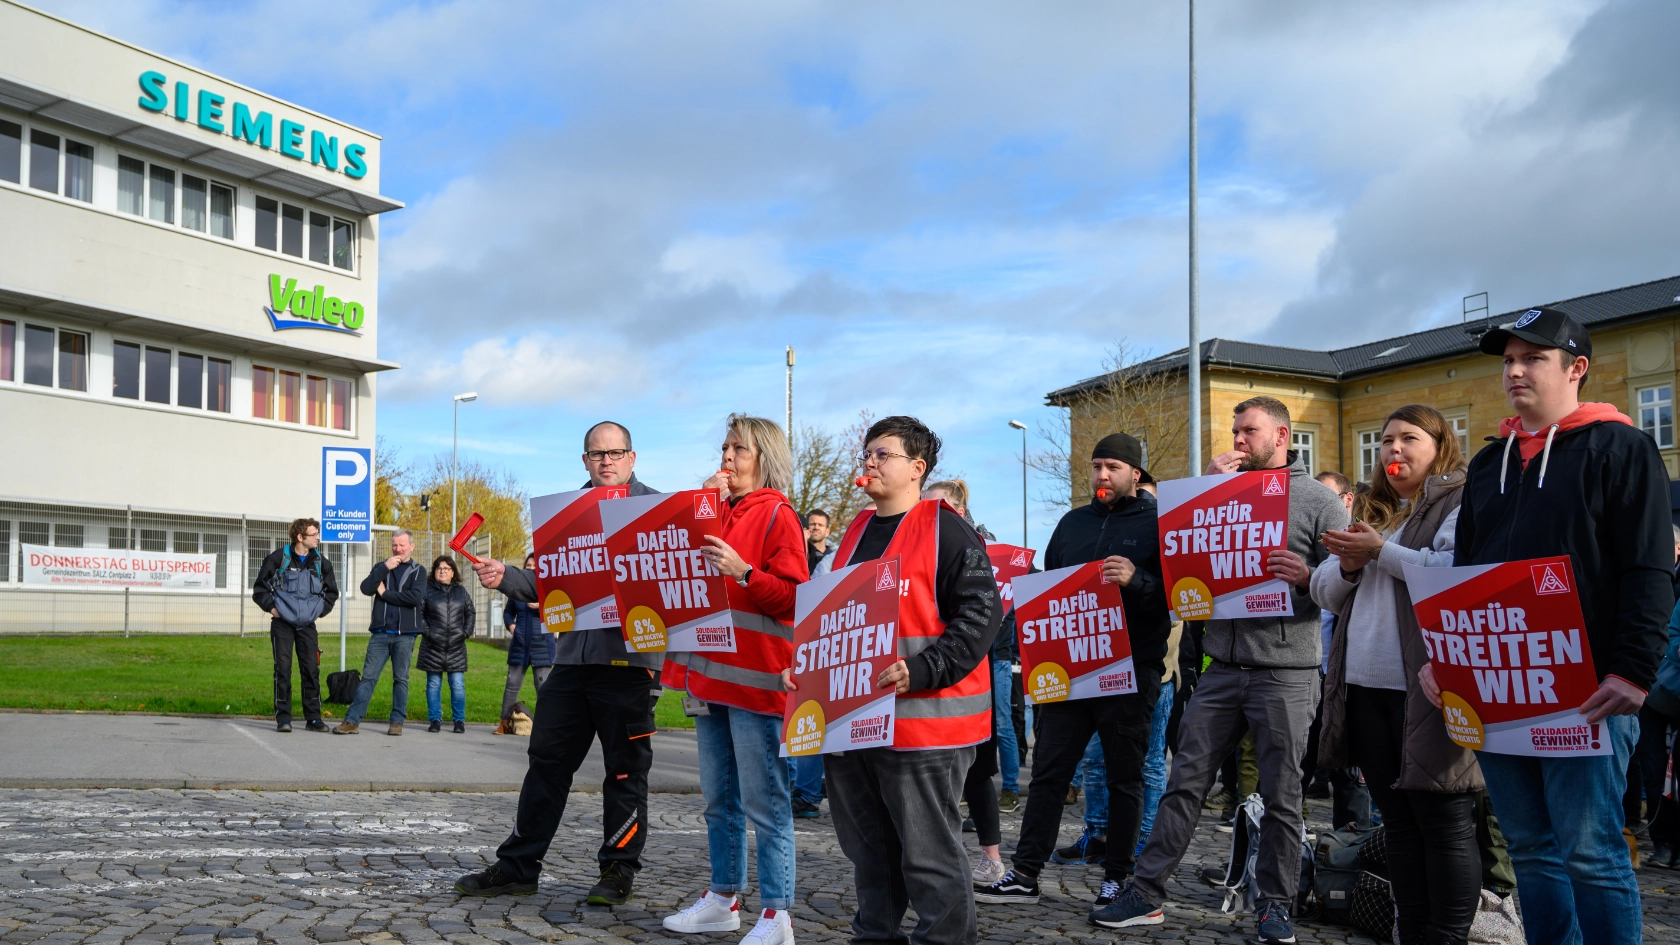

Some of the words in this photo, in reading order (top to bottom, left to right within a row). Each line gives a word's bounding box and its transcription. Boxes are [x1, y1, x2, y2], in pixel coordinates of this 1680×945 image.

[138, 70, 368, 179] SIEMENS
[268, 273, 365, 329] Valeo
[325, 450, 368, 506] P
[325, 509, 336, 517] für
[338, 509, 366, 518] Kunden
[1193, 500, 1252, 527] DAFÜR
[326, 522, 366, 531] Customers
[338, 531, 354, 540] only
[636, 524, 691, 552] DAFÜR
[1164, 521, 1284, 557] STREITEN
[30, 553, 127, 571] DONNERSTAG
[132, 559, 211, 574] BLUTSPENDE
[613, 549, 720, 582] STREITEN
[1210, 550, 1263, 580] WIR
[42, 568, 91, 577] Gemeindezentrum
[108, 571, 131, 580] Centplatz
[658, 579, 711, 610] WIR
[1245, 592, 1280, 601] SOLIDARITÄT
[1049, 589, 1098, 617] DAFÜR
[1189, 601, 1210, 610] WICHTIG
[819, 600, 867, 637] DAFÜR
[1191, 608, 1211, 616] RICHTIG
[1440, 602, 1528, 633] DAFÜR
[547, 613, 560, 626] FÜR
[1022, 606, 1123, 645] STREITEN
[644, 632, 664, 641] WICHTIG
[695, 626, 726, 634] SOLIDARITÄT
[647, 640, 666, 648] RICHTIG
[794, 622, 895, 675] STREITEN
[1067, 633, 1113, 663] WIR
[1421, 628, 1583, 667] STREITEN
[829, 661, 873, 702] WIR
[1098, 672, 1127, 681] SOLIDARITÄT
[1033, 688, 1045, 696] SIND
[1045, 683, 1067, 692] WICHTIG
[1472, 668, 1559, 704] WIR
[1047, 690, 1067, 699] RICHTIG
[851, 716, 883, 728] SOLIDARITÄT
[1455, 725, 1479, 735] WICHTIG
[1530, 725, 1588, 735] SOLIDARITÄT
[790, 736, 802, 745] SIND
[802, 731, 822, 742] WICHTIG
[1458, 734, 1481, 744] RICHTIG
[791, 744, 802, 753] UND
[802, 739, 821, 751] RICHTIG
